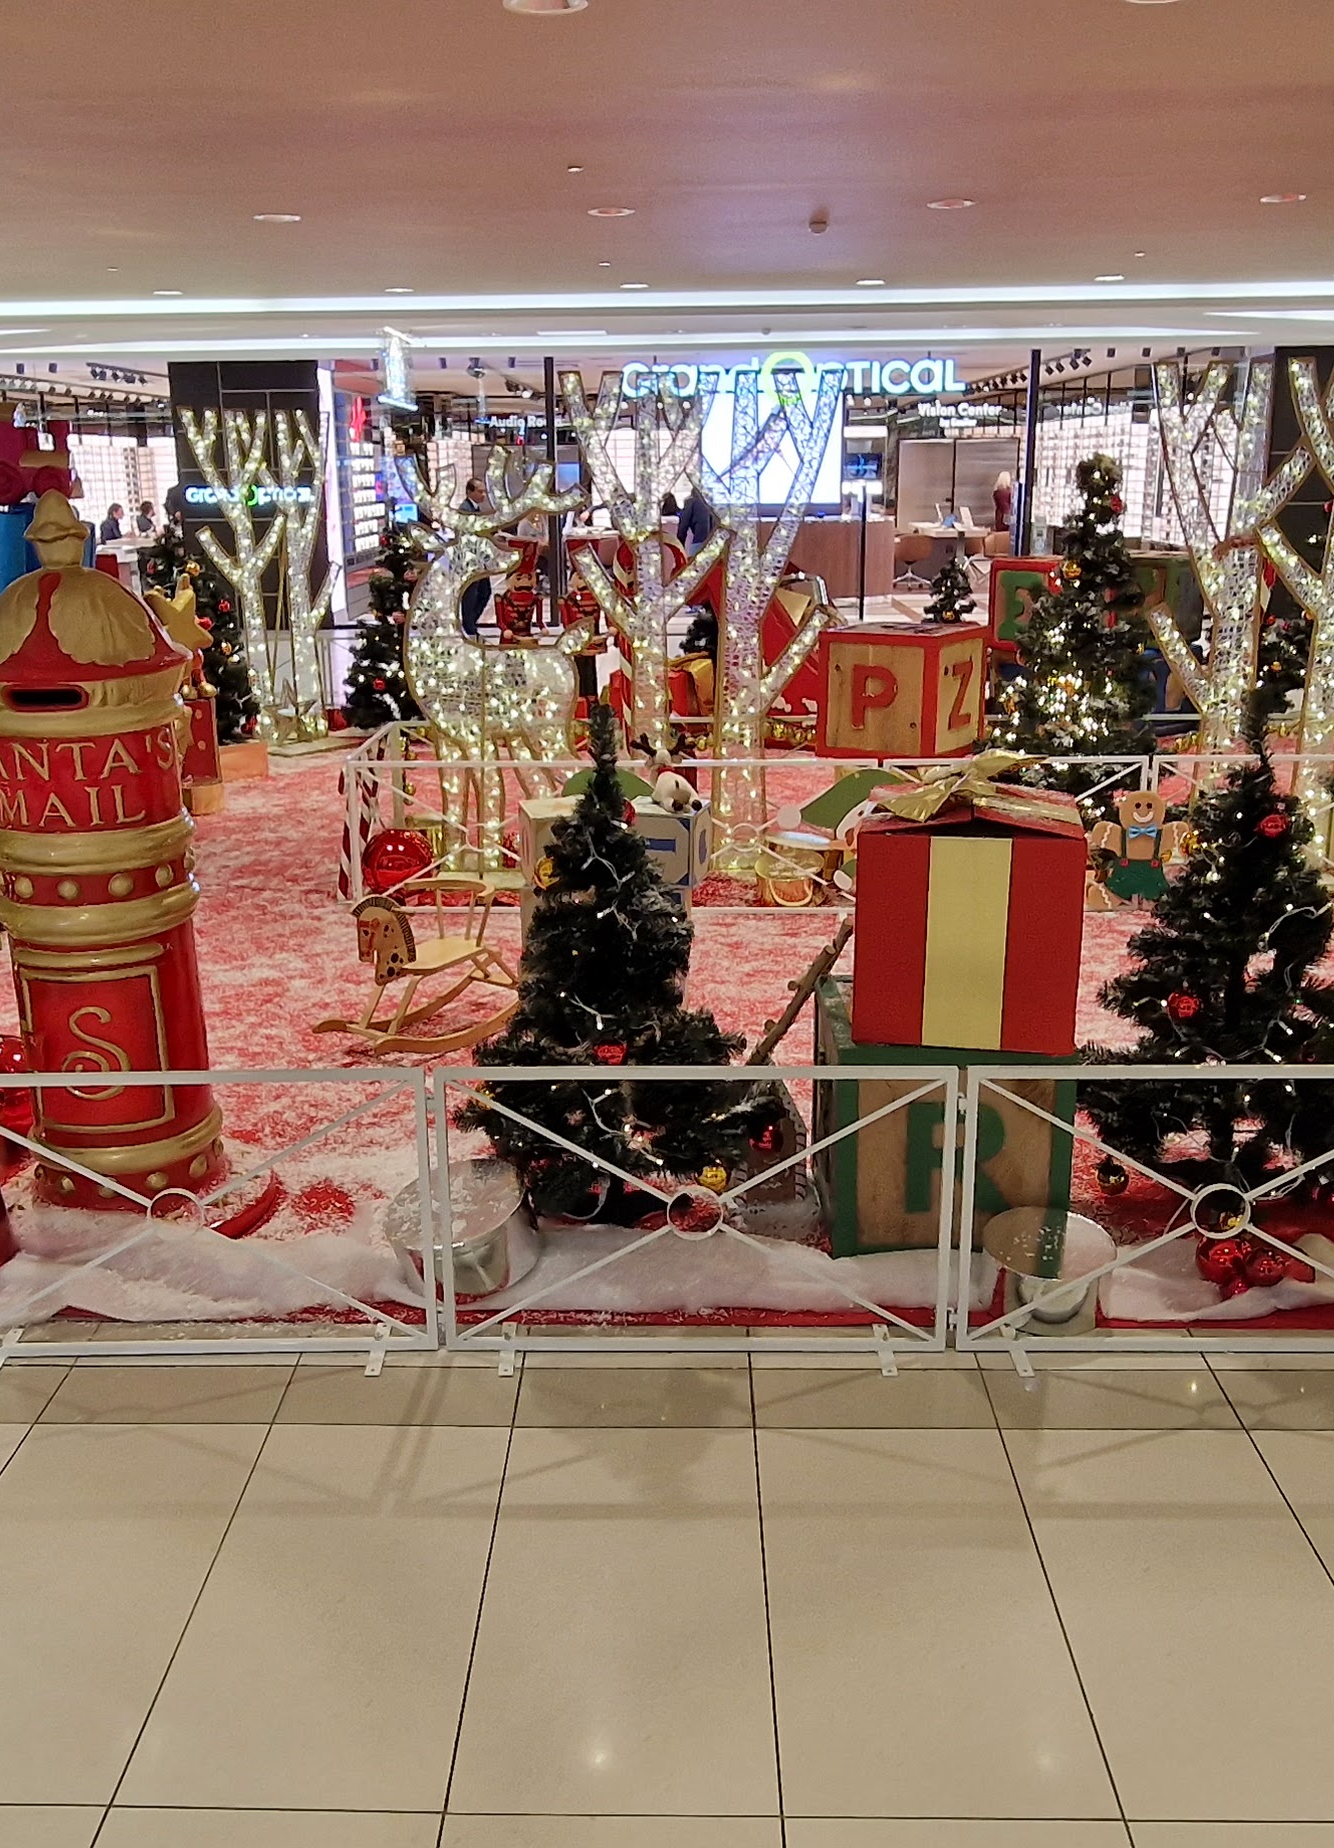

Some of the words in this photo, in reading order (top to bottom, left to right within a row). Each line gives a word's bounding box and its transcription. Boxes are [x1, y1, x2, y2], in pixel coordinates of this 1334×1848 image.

[917, 400, 956, 417] Vision
[957, 402, 1002, 417] Center
[851, 665, 898, 729] P
[949, 660, 974, 730] Z
[906, 1102, 1013, 1212] R
